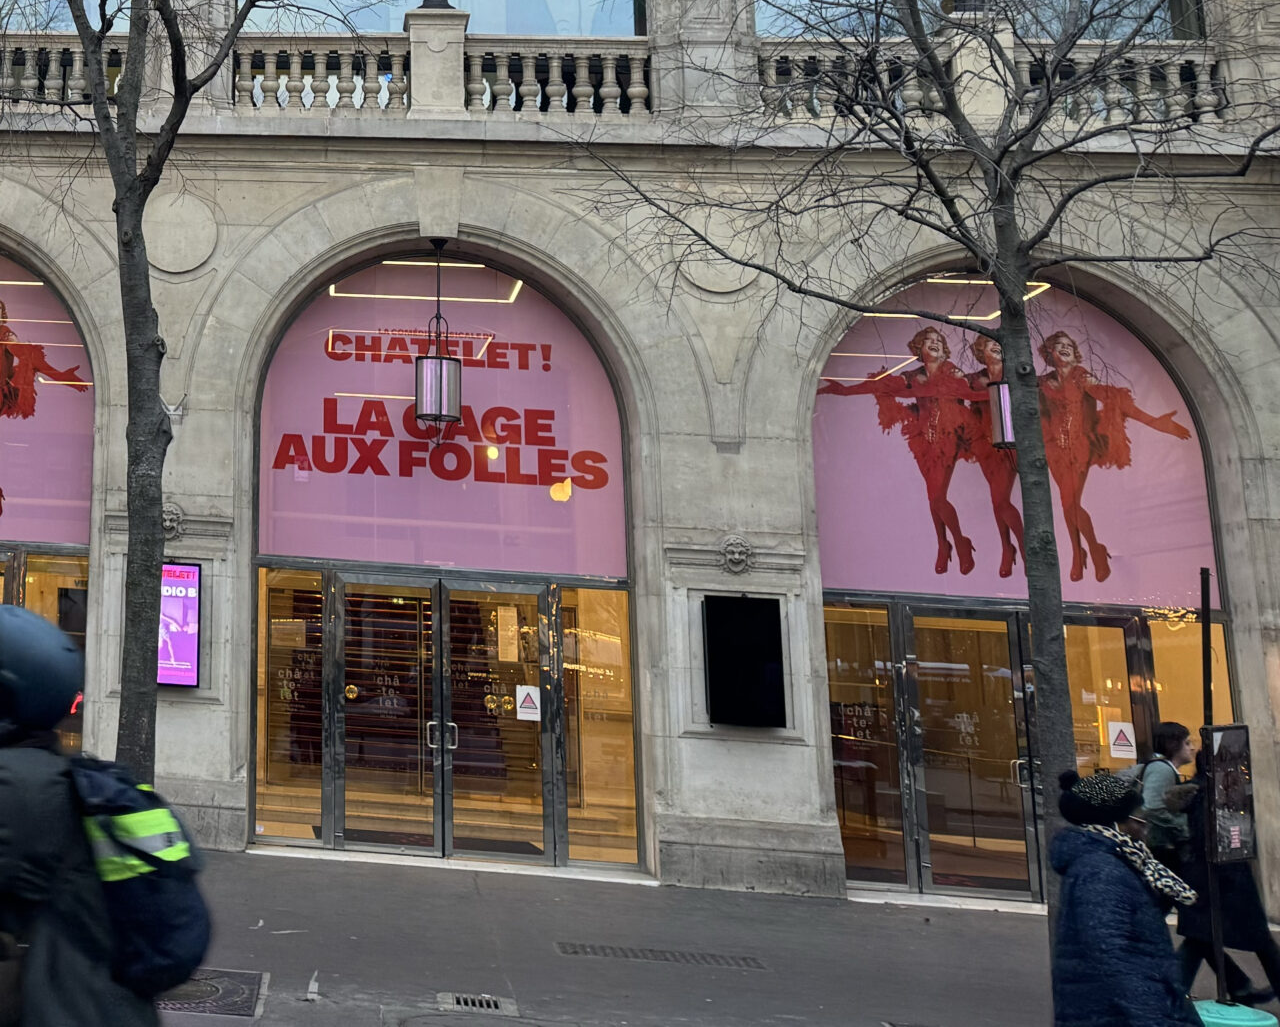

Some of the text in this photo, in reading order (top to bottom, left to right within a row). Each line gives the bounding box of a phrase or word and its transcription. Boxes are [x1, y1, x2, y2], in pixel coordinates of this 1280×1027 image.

[323, 397, 557, 448] LA CAGE
[272, 433, 610, 491] AUX FOLLES
[187, 587, 197, 598] B
[377, 686, 400, 697] -te-
[379, 696, 399, 708] let
[847, 716, 873, 728] -te-
[850, 727, 872, 740] let
